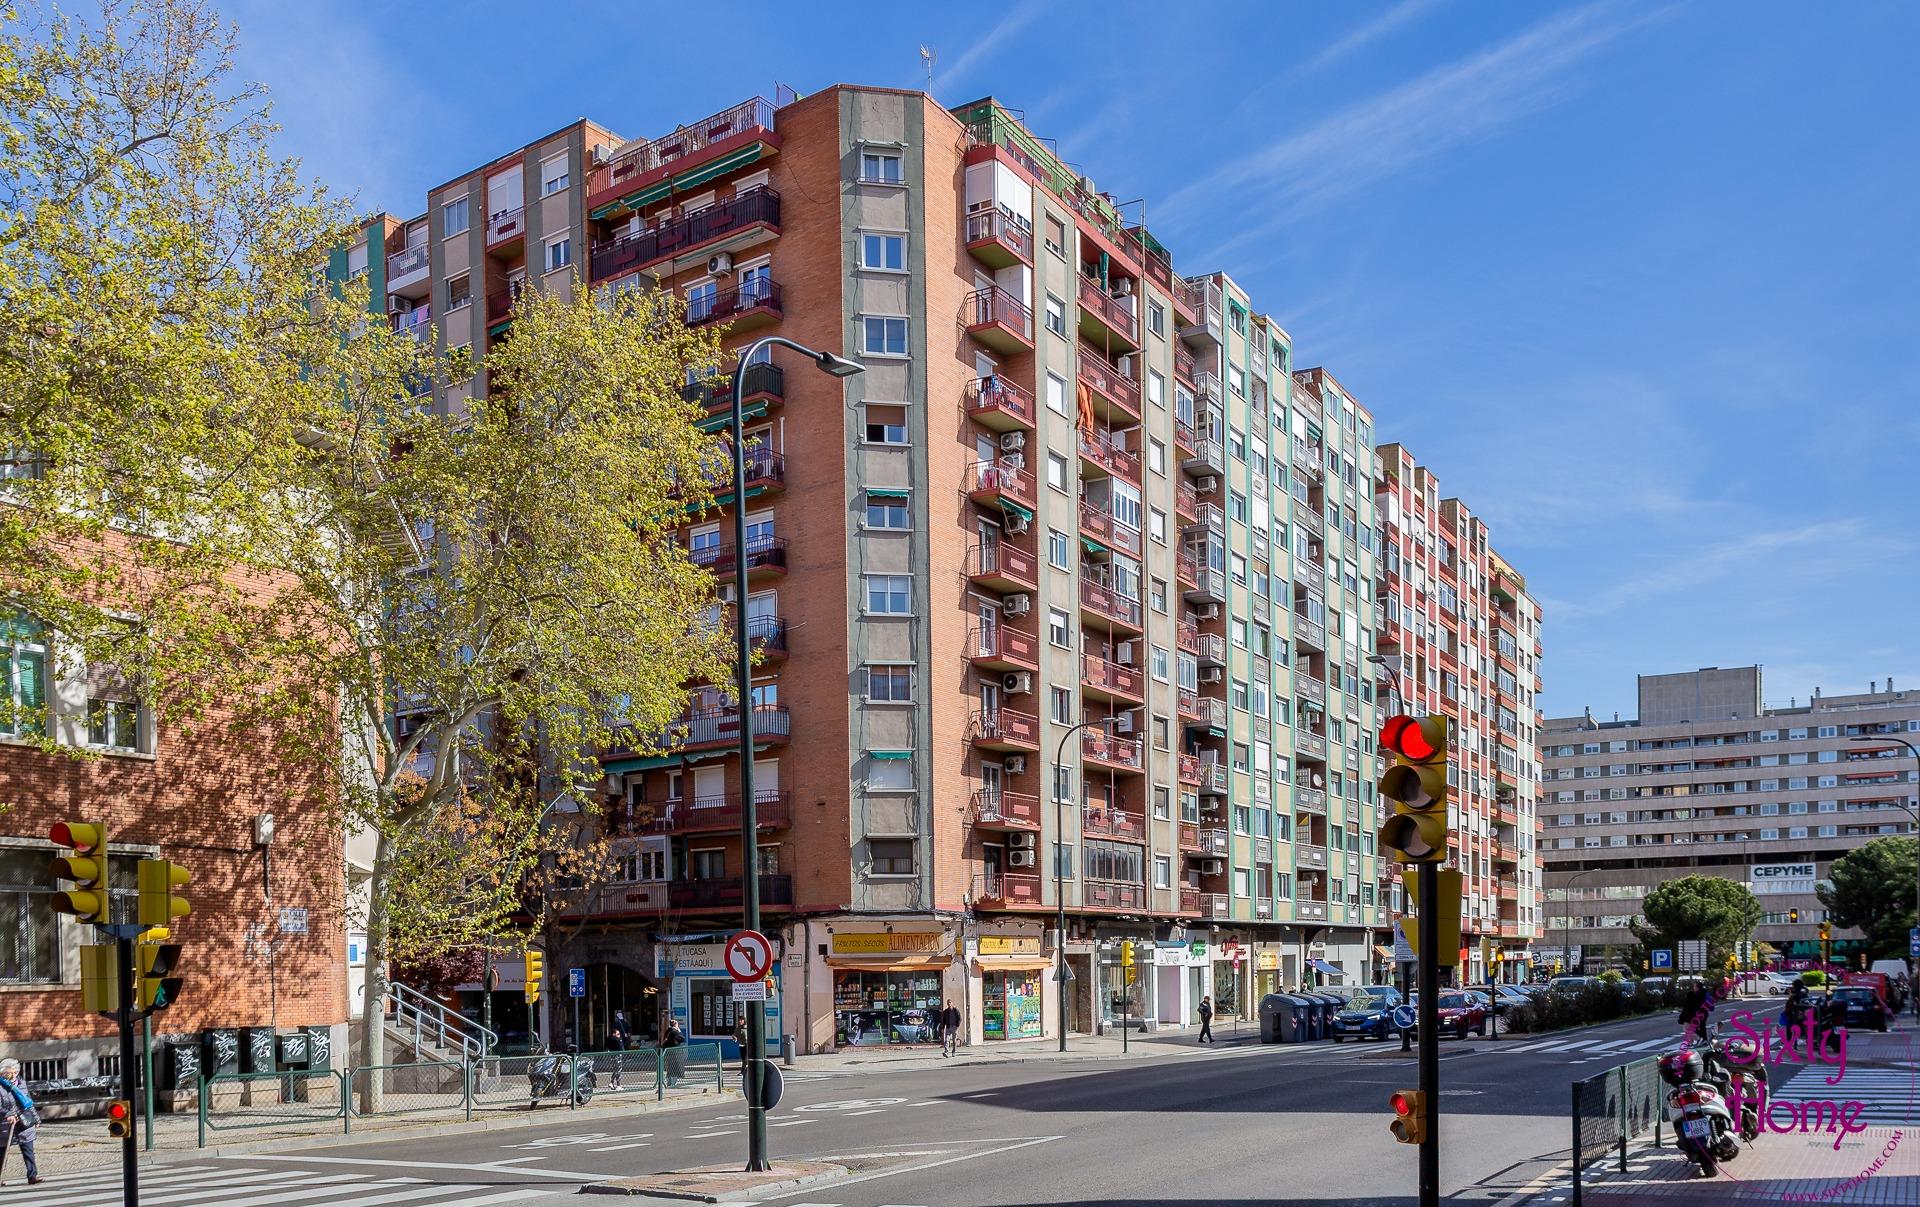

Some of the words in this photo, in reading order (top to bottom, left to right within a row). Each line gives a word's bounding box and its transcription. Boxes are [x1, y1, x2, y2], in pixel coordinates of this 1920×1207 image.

[1754, 865, 1813, 877] CEPYME
[835, 940, 861, 948] FRUTOS
[863, 940, 885, 948] SECOS
